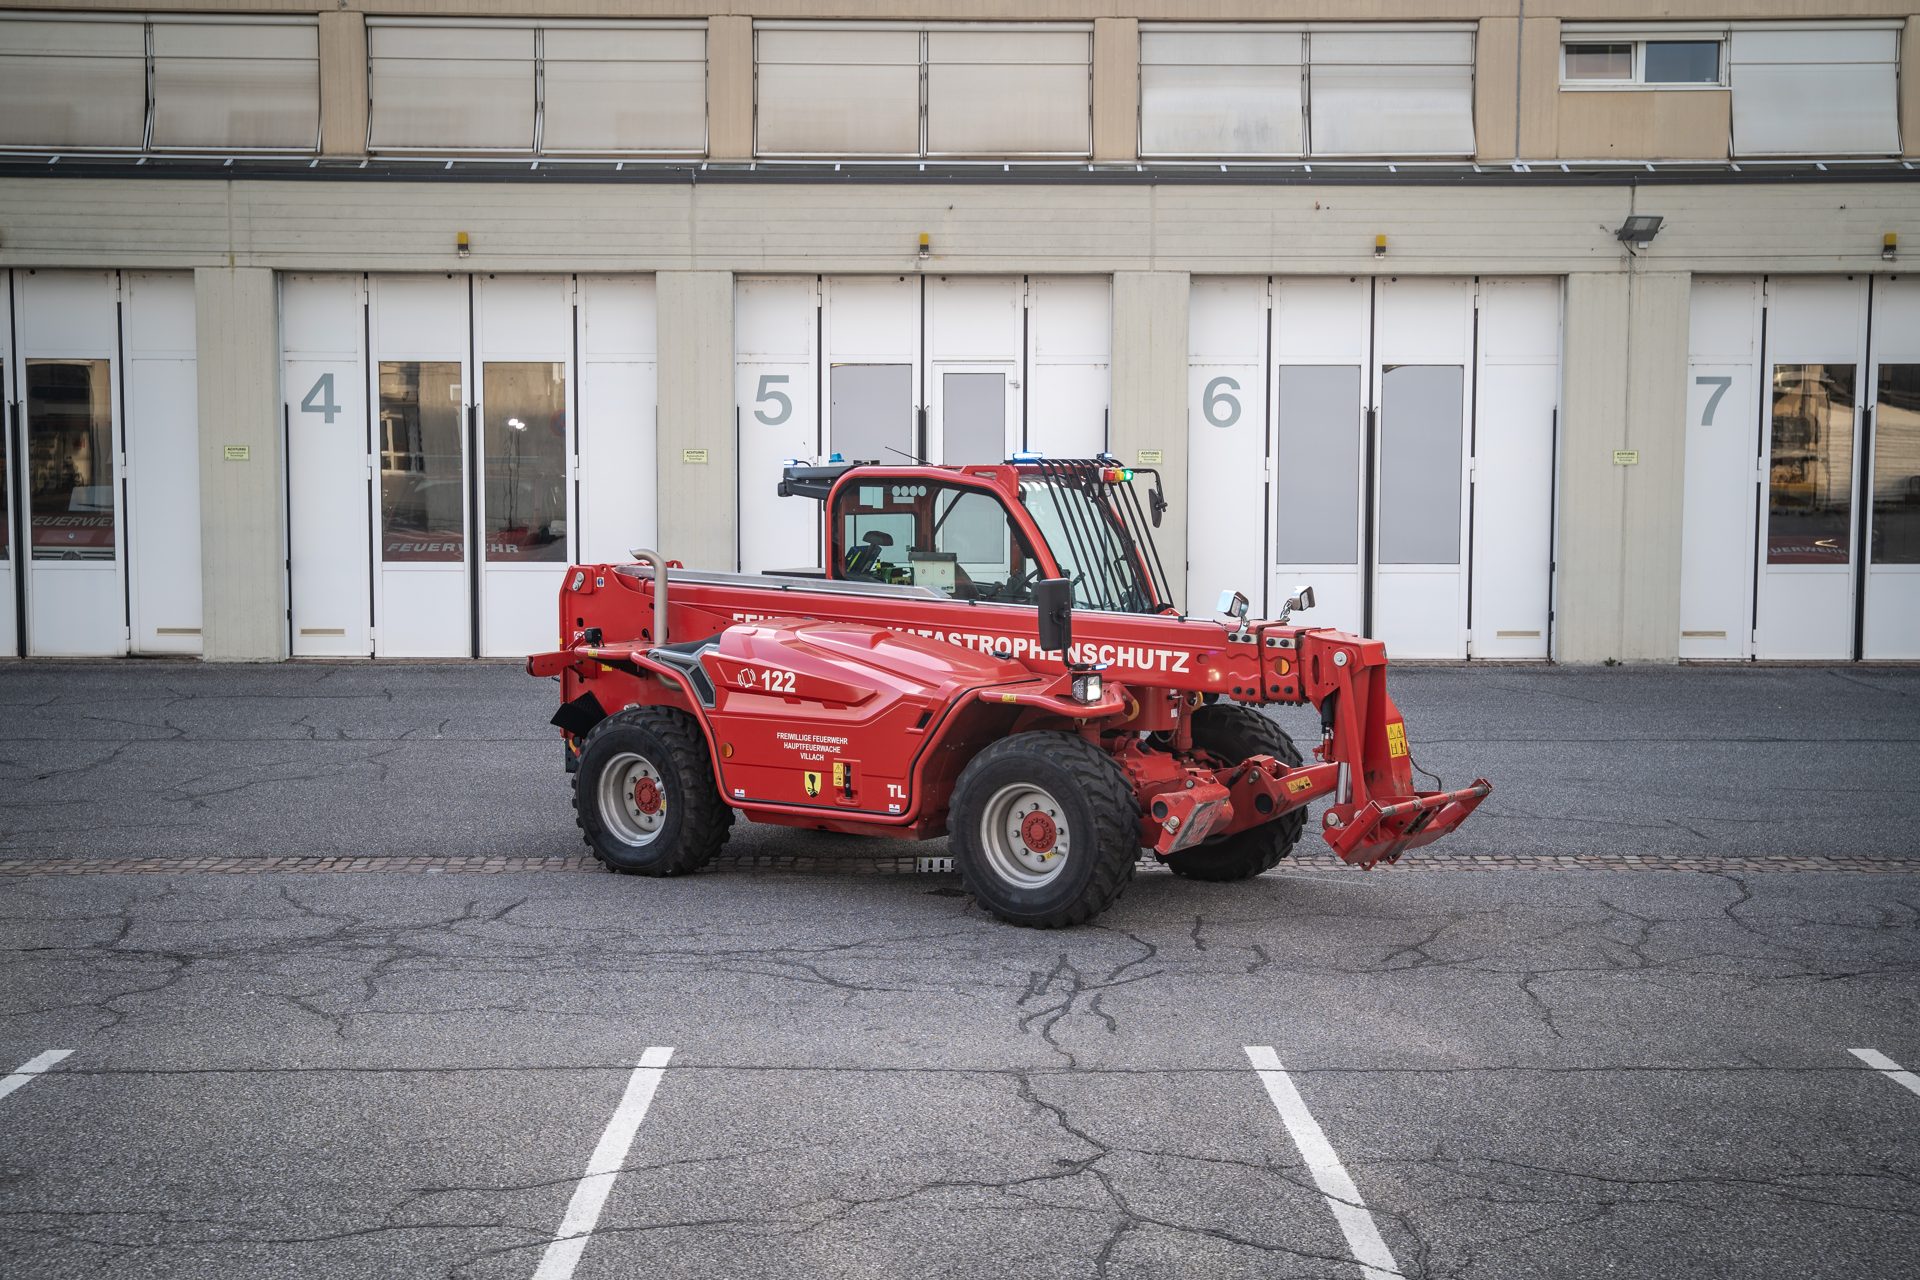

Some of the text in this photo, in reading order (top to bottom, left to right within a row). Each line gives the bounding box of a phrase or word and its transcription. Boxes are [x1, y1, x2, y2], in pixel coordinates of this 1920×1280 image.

[301, 373, 342, 424] 4
[753, 375, 793, 426] 5
[1202, 376, 1242, 428] 6
[1695, 376, 1733, 426] 7
[32, 515, 114, 528] EUERWE
[386, 542, 519, 553] FEUERHR
[887, 626, 1191, 674] TASTROPHENSCHUTZ
[761, 669, 796, 693] 122
[776, 732, 849, 745] FREIWILLIGE FEUERWEHR
[783, 741, 841, 754] HAUPTFEUERWACHE
[800, 752, 825, 762] VILLACH
[887, 784, 907, 799] TL
